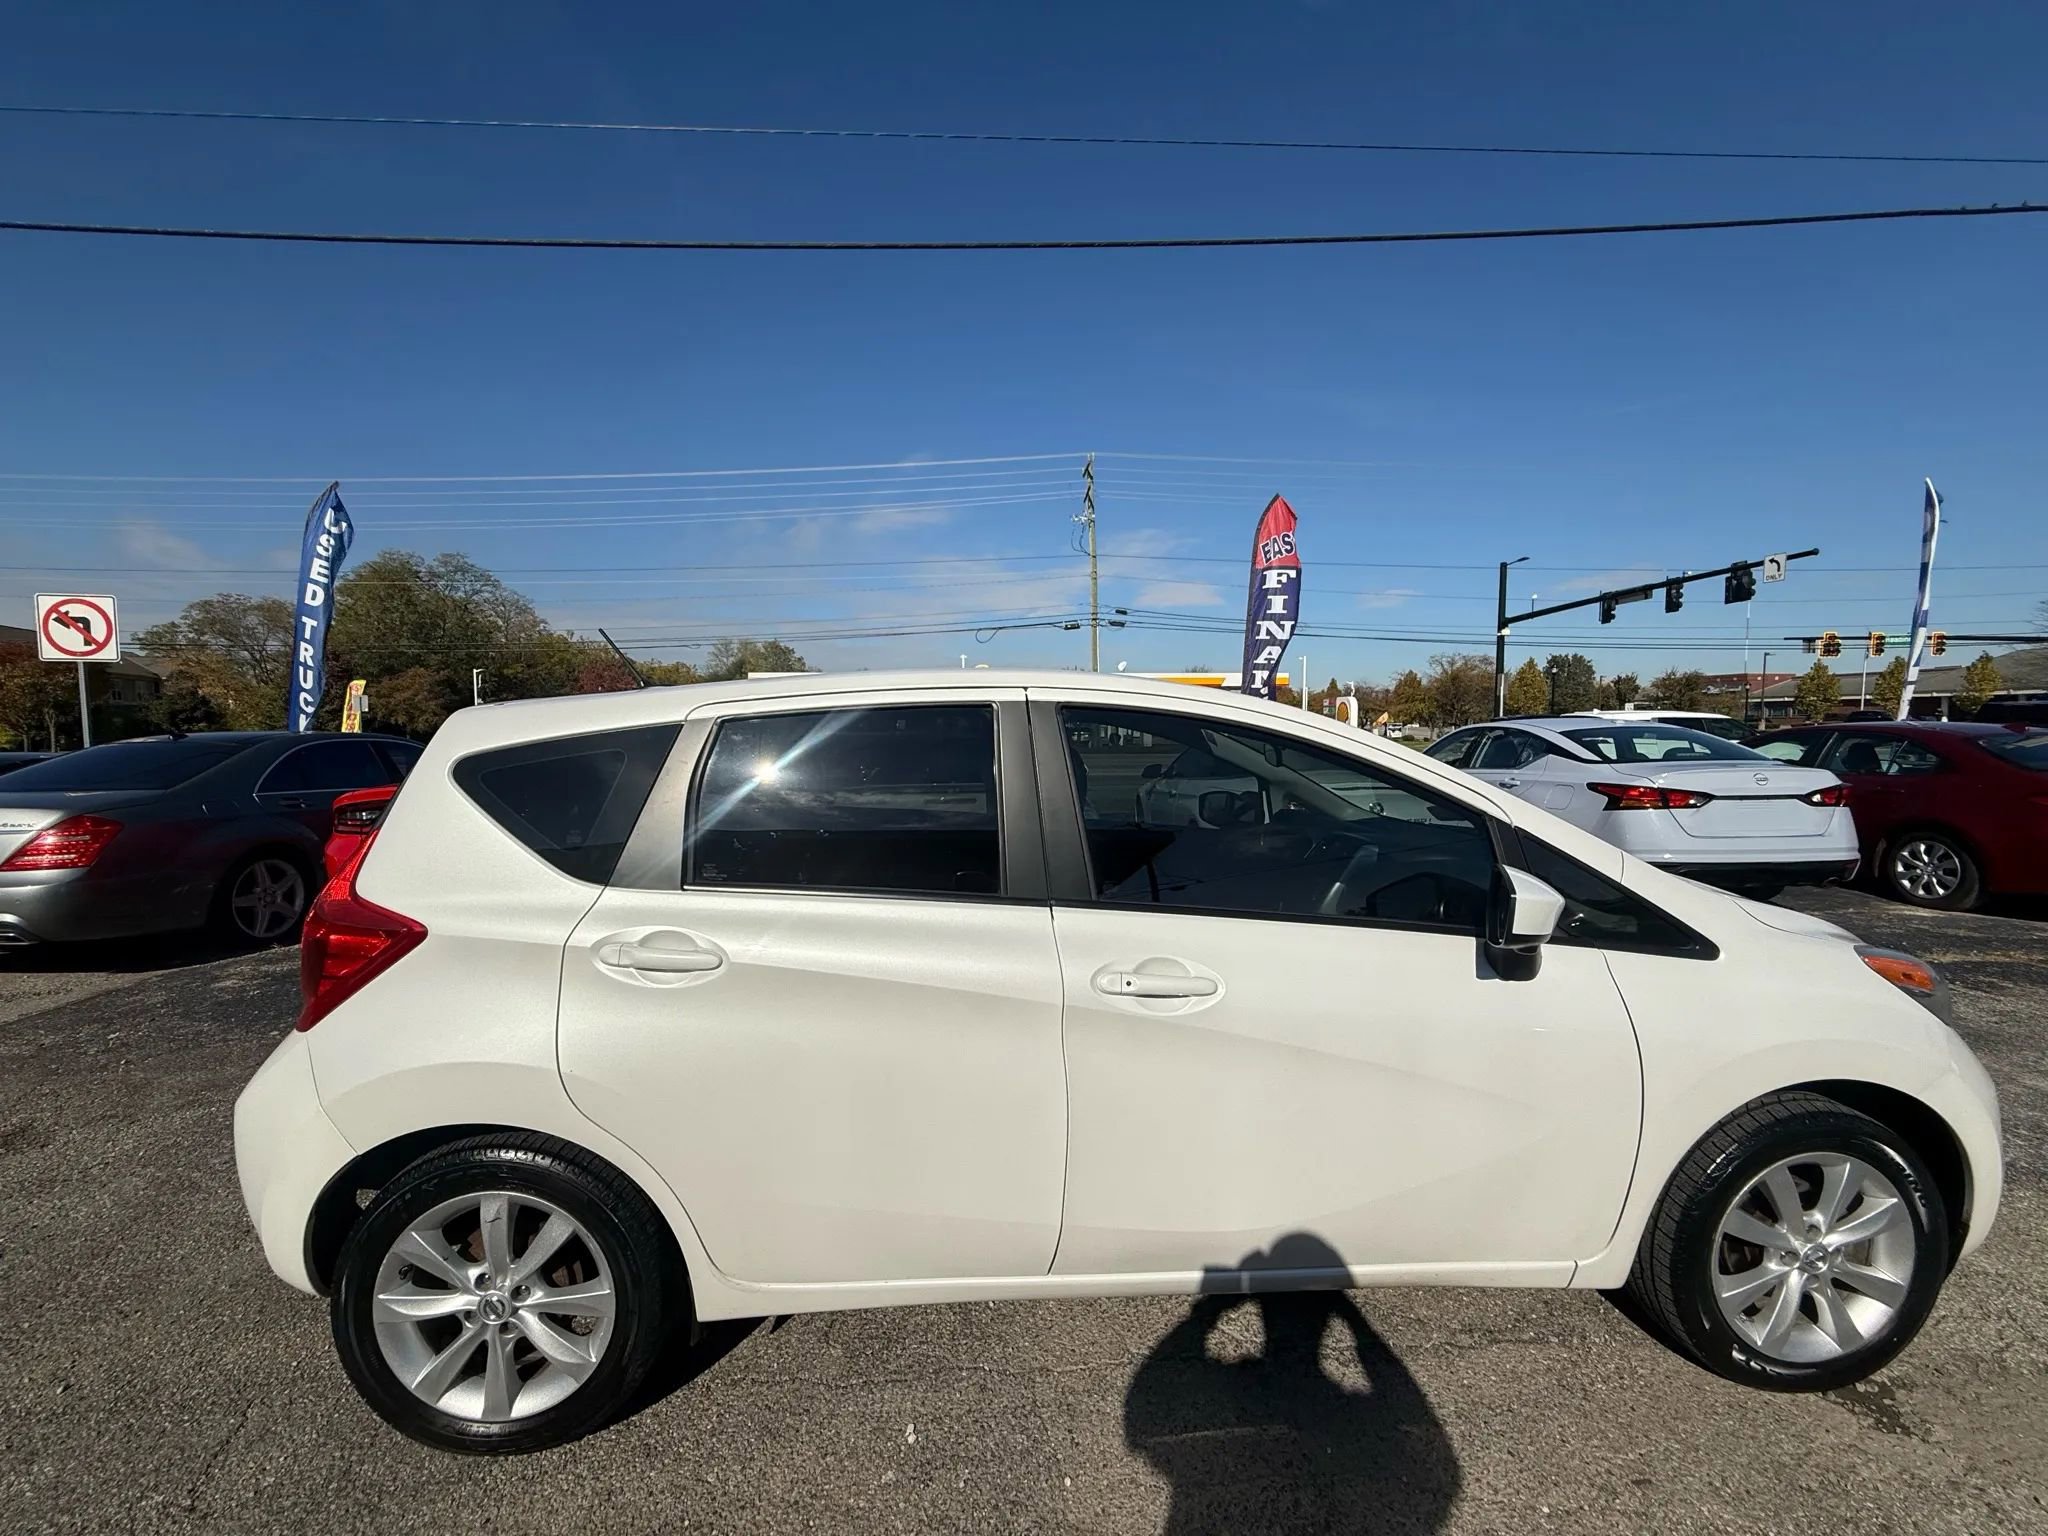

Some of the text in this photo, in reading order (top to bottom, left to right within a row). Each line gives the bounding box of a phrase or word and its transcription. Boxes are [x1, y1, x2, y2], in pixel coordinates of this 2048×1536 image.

[303, 508, 348, 607] USED
[1260, 531, 1296, 566] EAS
[1765, 573, 1783, 581] ONLY
